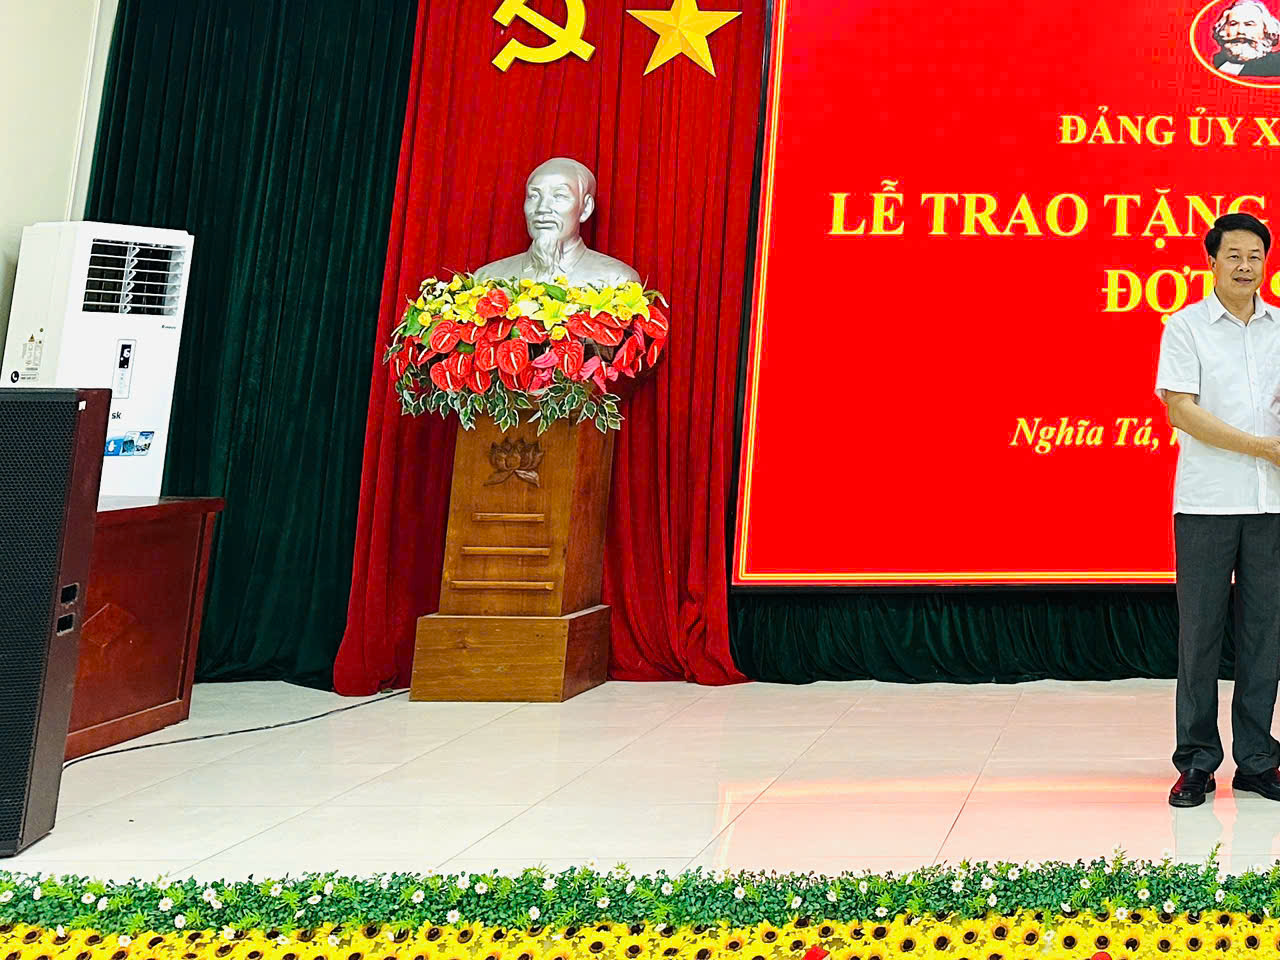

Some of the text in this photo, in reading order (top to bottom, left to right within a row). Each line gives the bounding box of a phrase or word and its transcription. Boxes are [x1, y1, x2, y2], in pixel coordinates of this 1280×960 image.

[1059, 106, 1176, 145] ĐẢNG
[1188, 107, 1243, 146] ỦY
[828, 180, 905, 236] LỄ
[920, 193, 1089, 237] TRAO
[1009, 417, 1104, 454] Nghĩa
[1114, 417, 1160, 451] Tá,
